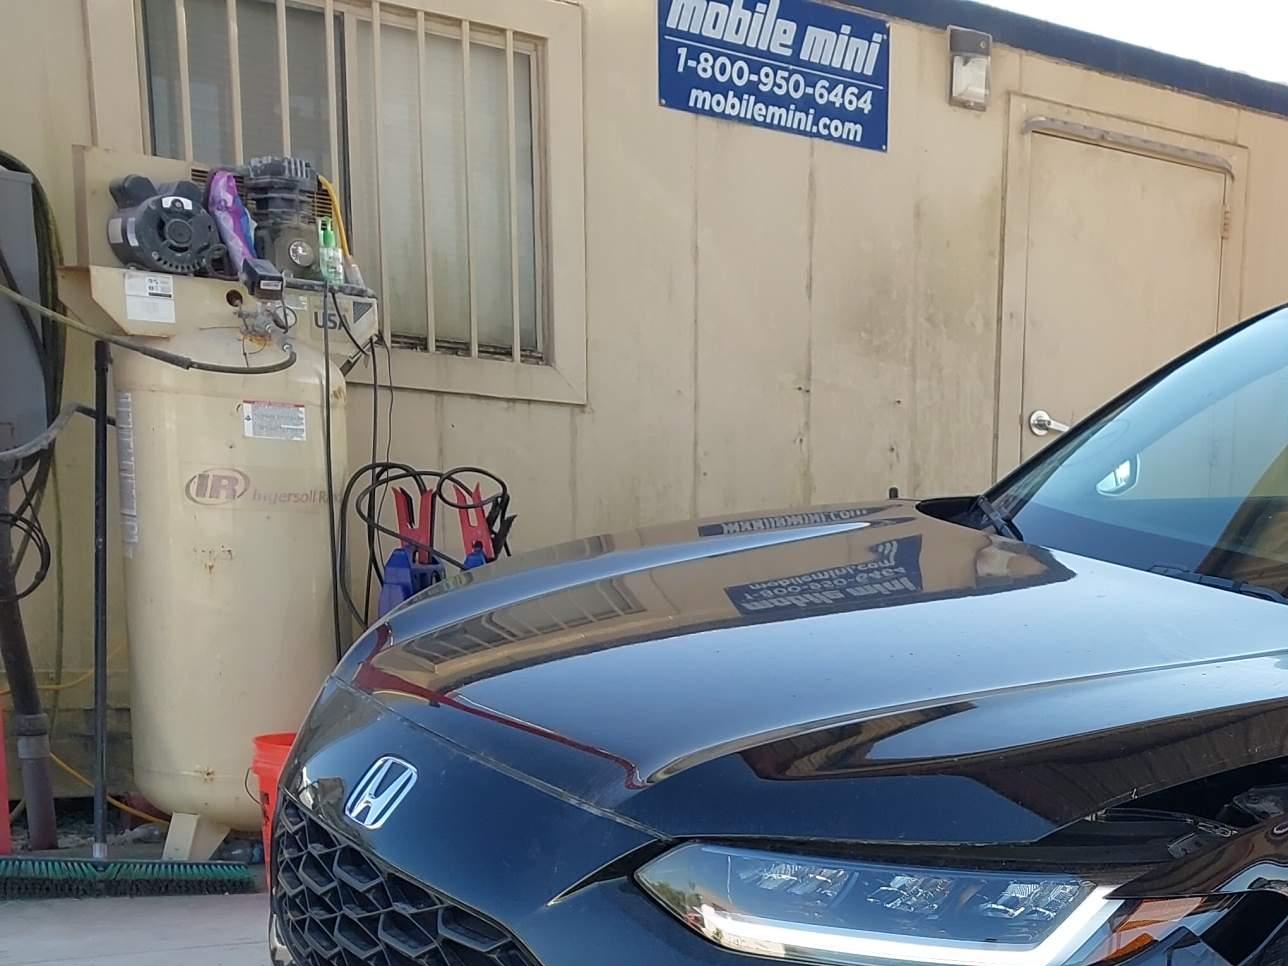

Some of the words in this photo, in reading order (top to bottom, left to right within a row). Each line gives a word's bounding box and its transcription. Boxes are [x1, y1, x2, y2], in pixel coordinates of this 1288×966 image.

[666, 0, 797, 56] mobile
[799, 24, 882, 75] mini
[675, 47, 873, 114] 1-800-950-6464
[688, 87, 863, 142] mobilemini.com
[313, 311, 351, 331] USA
[195, 473, 239, 499] IR
